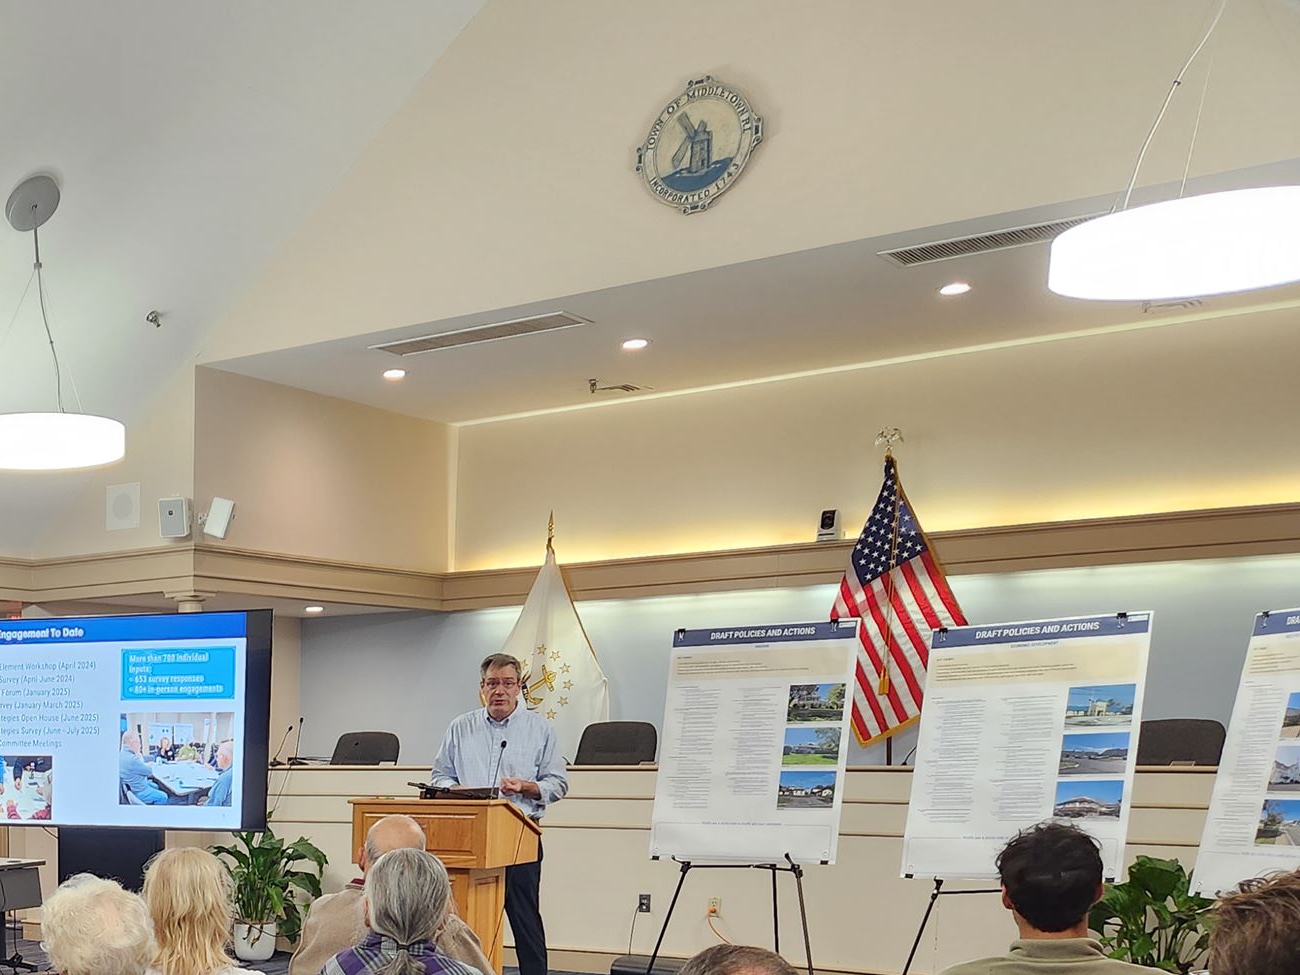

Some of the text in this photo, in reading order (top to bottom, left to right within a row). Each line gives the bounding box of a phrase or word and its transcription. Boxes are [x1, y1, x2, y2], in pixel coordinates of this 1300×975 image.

[646, 119, 664, 151] TOWN
[666, 98, 682, 115] OF
[686, 86, 748, 117] MIDDLETOWN
[649, 176, 710, 203] INCORPORATED
[50, 627, 61, 638] To
[62, 626, 85, 638] Date
[710, 626, 816, 640] DRAFT POLICIES AND ACTIONS
[975, 621, 1100, 640] DRAFT POLICIES AND ACTIONS
[25, 661, 57, 671] Workshop
[58, 660, 76, 671] (April
[77, 660, 96, 671] 2024)
[56, 674, 75, 684] 2024)
[170, 674, 205, 684] responses
[1, 688, 22, 697] Forum
[22, 687, 51, 698] (January
[51, 687, 71, 697] 2025)
[64, 700, 84, 710] 2025)
[20, 713, 38, 723] Open
[38, 713, 59, 722] House
[60, 713, 79, 723] (June
[80, 713, 100, 723] 2025)
[20, 726, 42, 736] Survey
[43, 726, 61, 735] (June
[66, 726, 80, 736] July
[80, 726, 100, 736] 2025)
